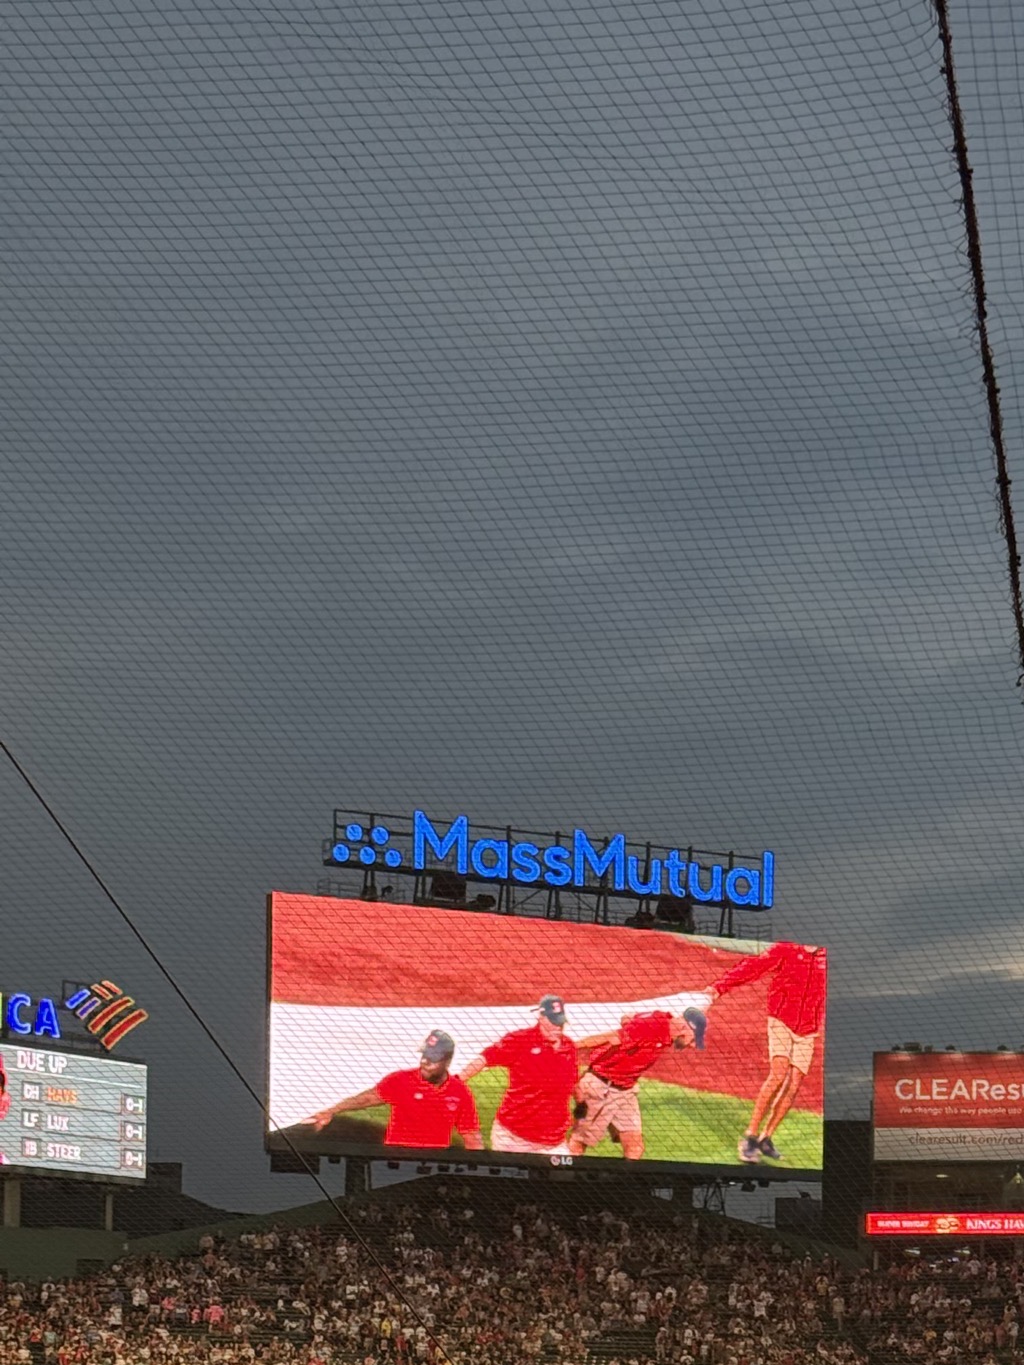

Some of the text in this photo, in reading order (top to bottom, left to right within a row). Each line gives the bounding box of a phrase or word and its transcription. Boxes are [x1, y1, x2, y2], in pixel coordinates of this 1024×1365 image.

[414, 809, 775, 910] MassMutual
[0, 991, 60, 1038] CA
[17, 1051, 67, 1074] DUE UP
[978, 1107, 1006, 1116] people
[47, 1115, 69, 1131] LUX
[47, 1143, 82, 1161] STEER
[561, 1156, 573, 1165] LG
